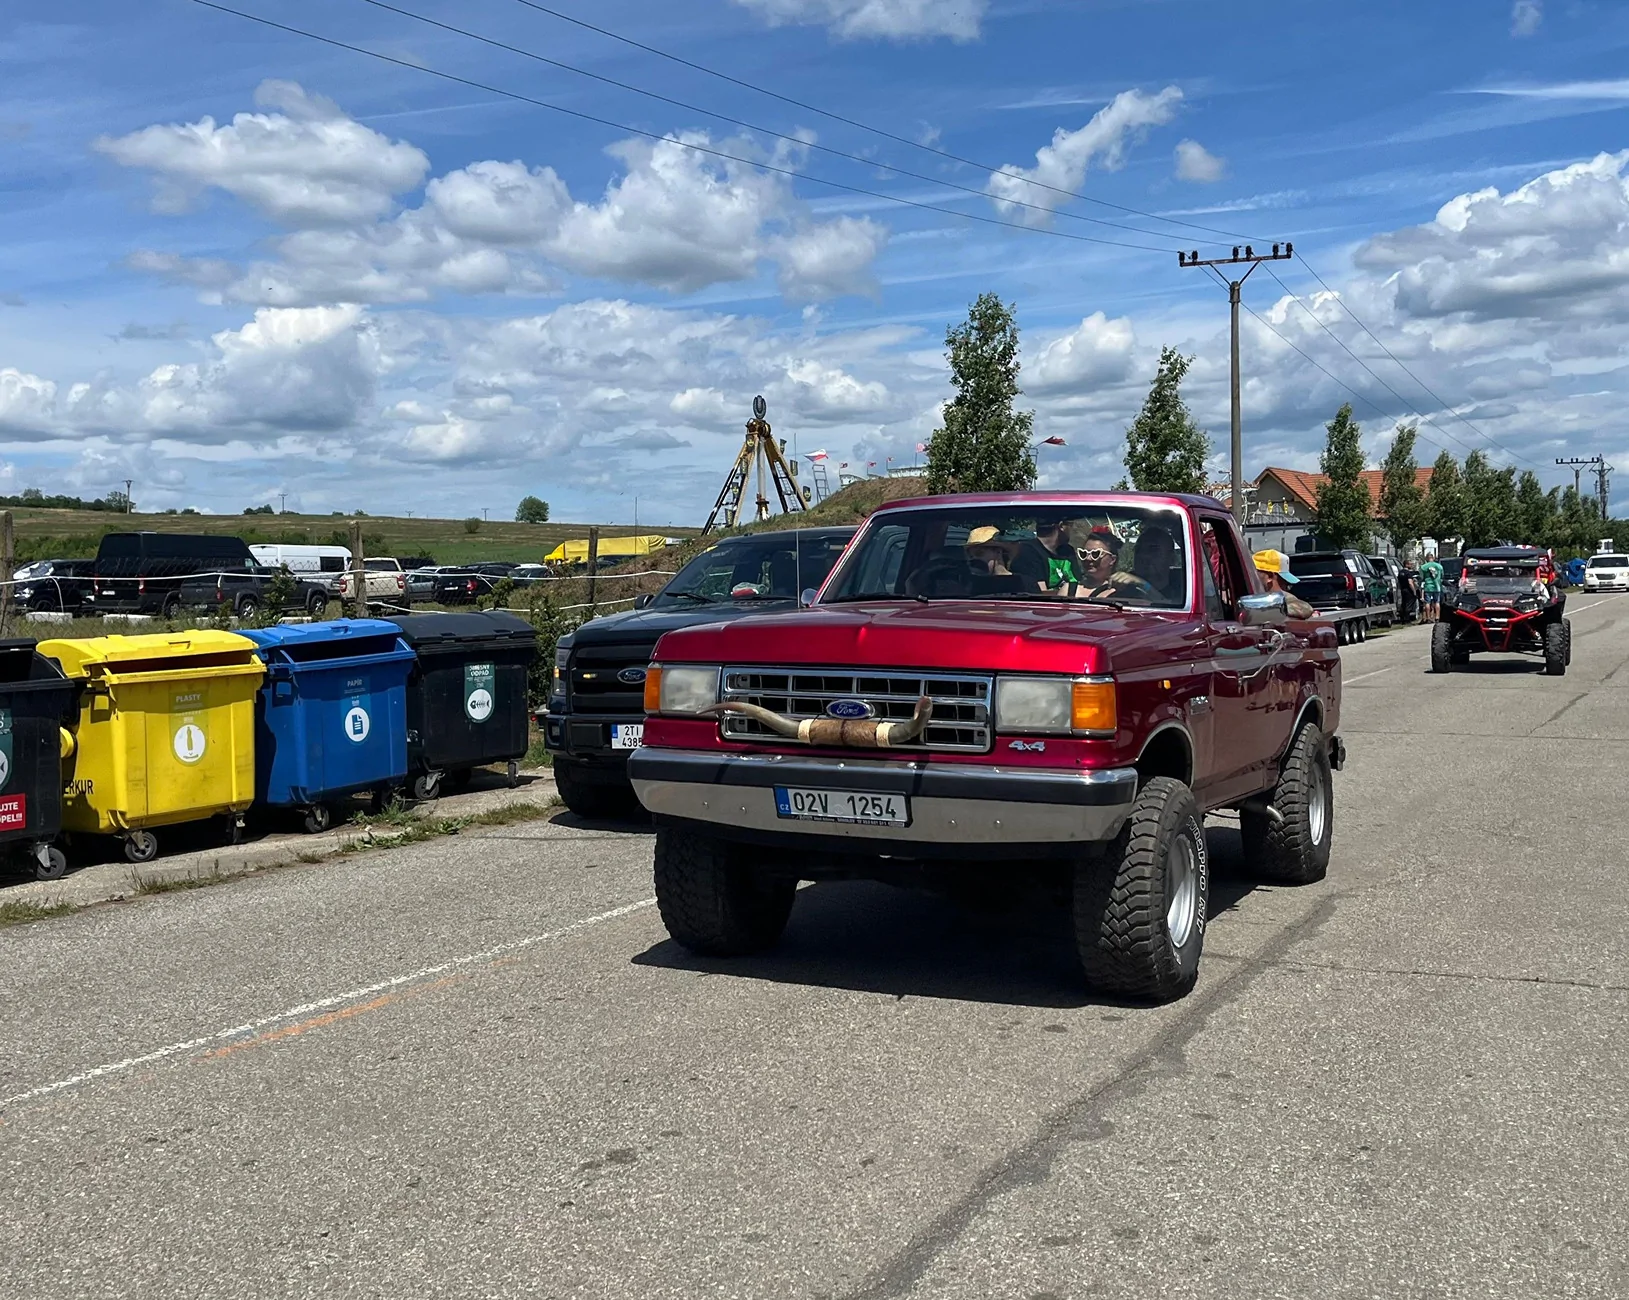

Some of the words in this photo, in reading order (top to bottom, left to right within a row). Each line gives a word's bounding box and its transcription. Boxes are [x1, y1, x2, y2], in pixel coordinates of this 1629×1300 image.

[175, 693, 201, 703] PLASTY
[622, 737, 643, 747] 4385
[847, 795, 896, 817] 1254
